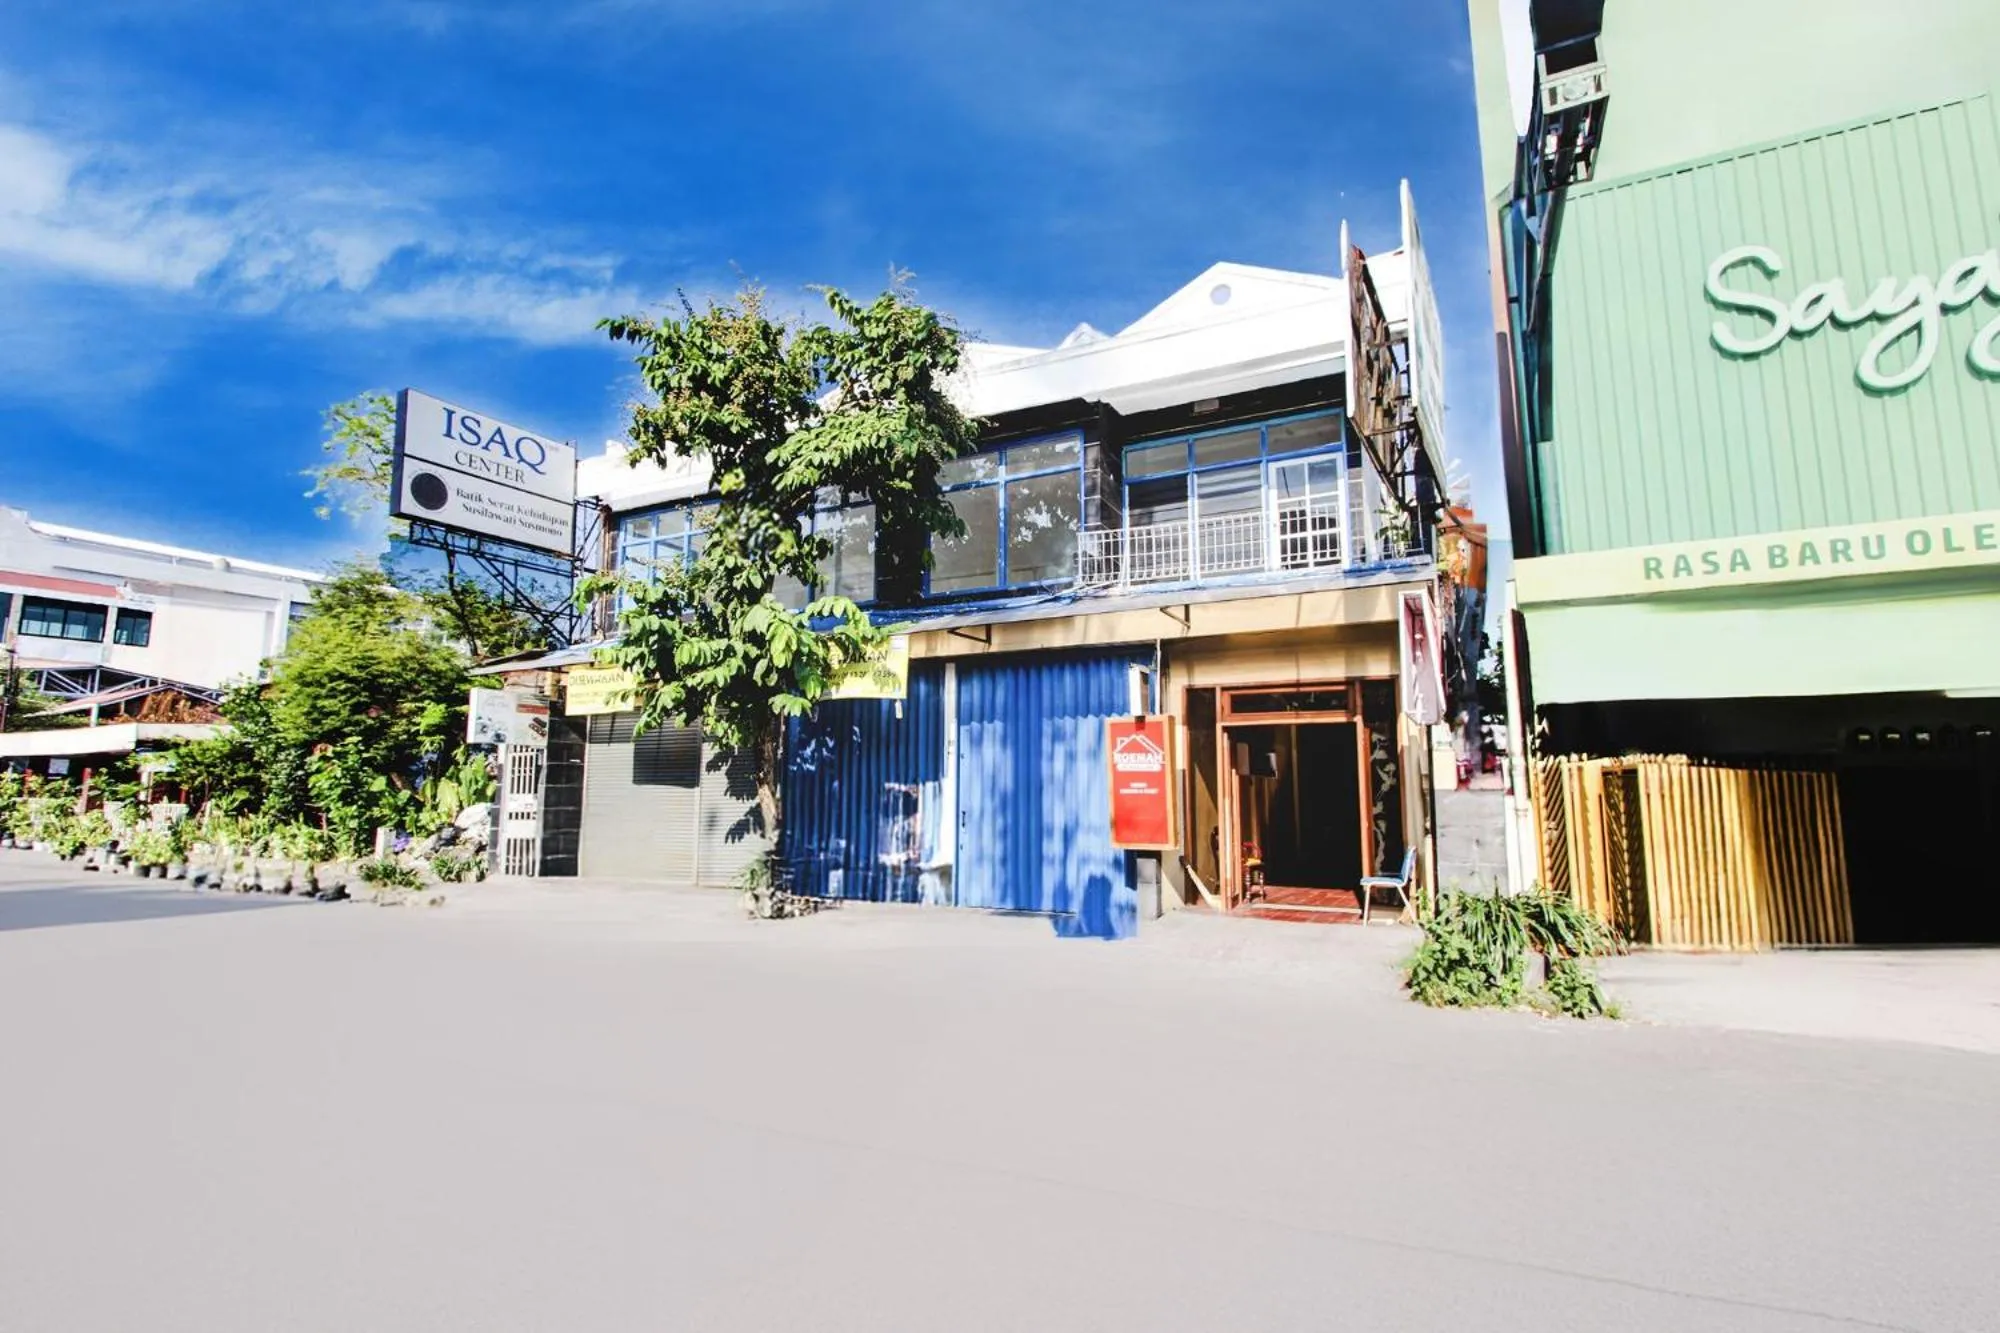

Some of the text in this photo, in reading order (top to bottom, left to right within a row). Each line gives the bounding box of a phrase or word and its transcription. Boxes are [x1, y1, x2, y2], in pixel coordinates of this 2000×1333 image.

[1706, 245, 2000, 394] Saya
[442, 407, 547, 475] ISAQ
[455, 450, 526, 484] CENTER
[456, 487, 484, 503] Batik
[1642, 547, 1752, 581] RASA
[1766, 533, 1887, 570] BARU
